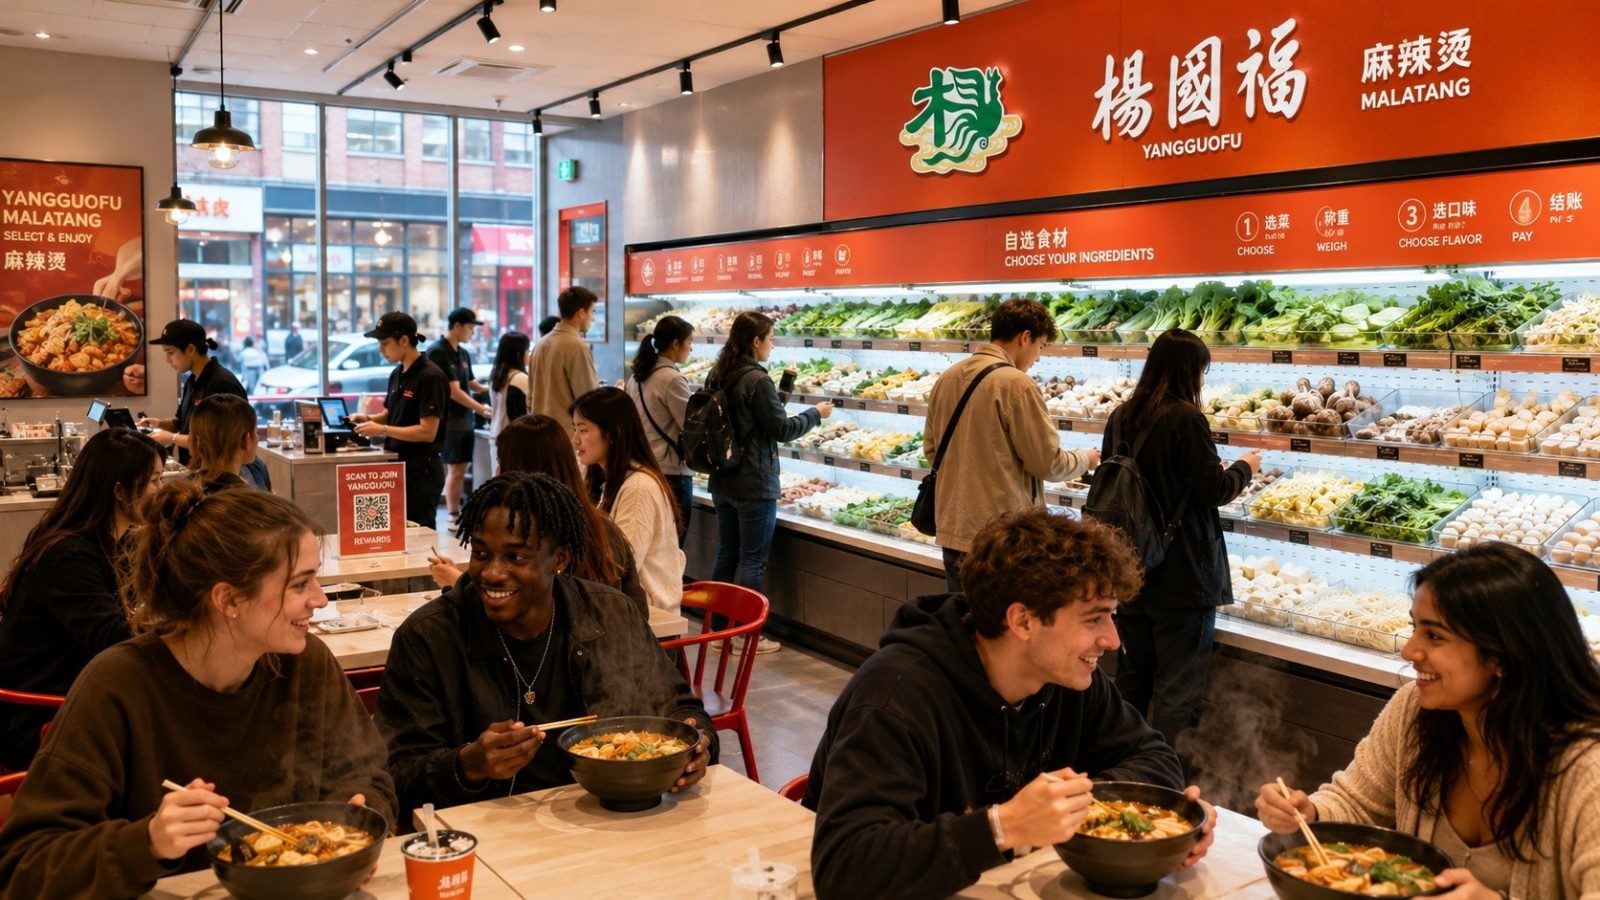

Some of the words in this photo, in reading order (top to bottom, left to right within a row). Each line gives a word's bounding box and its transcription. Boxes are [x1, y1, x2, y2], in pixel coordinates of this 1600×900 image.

[1361, 27, 1472, 83] 麻辣烫
[1091, 16, 1308, 141] 楊國福
[1361, 77, 1471, 111] MALATANG
[1142, 132, 1243, 159] YANGGUOFU
[2, 189, 122, 210] YANGGUOFU
[1432, 199, 1477, 220] 选口味
[3, 209, 102, 228] MALATANG
[1406, 205, 1418, 226] 3
[3, 230, 45, 242] SELECT
[47, 232, 56, 243] &
[58, 233, 93, 244] ENJOY
[1005, 227, 1069, 251] 自选食材
[1316, 240, 1348, 252] WEIGH
[1398, 235, 1440, 249] CHOOSE
[1442, 233, 1483, 246] FLAVOR
[1512, 230, 1534, 242] PAY
[1005, 253, 1045, 267] CHOOSE
[1048, 251, 1077, 265] YOUR
[1079, 247, 1155, 263] INGREDIENTS
[1237, 244, 1275, 256] CHOOSE
[368, 472, 378, 480] TO
